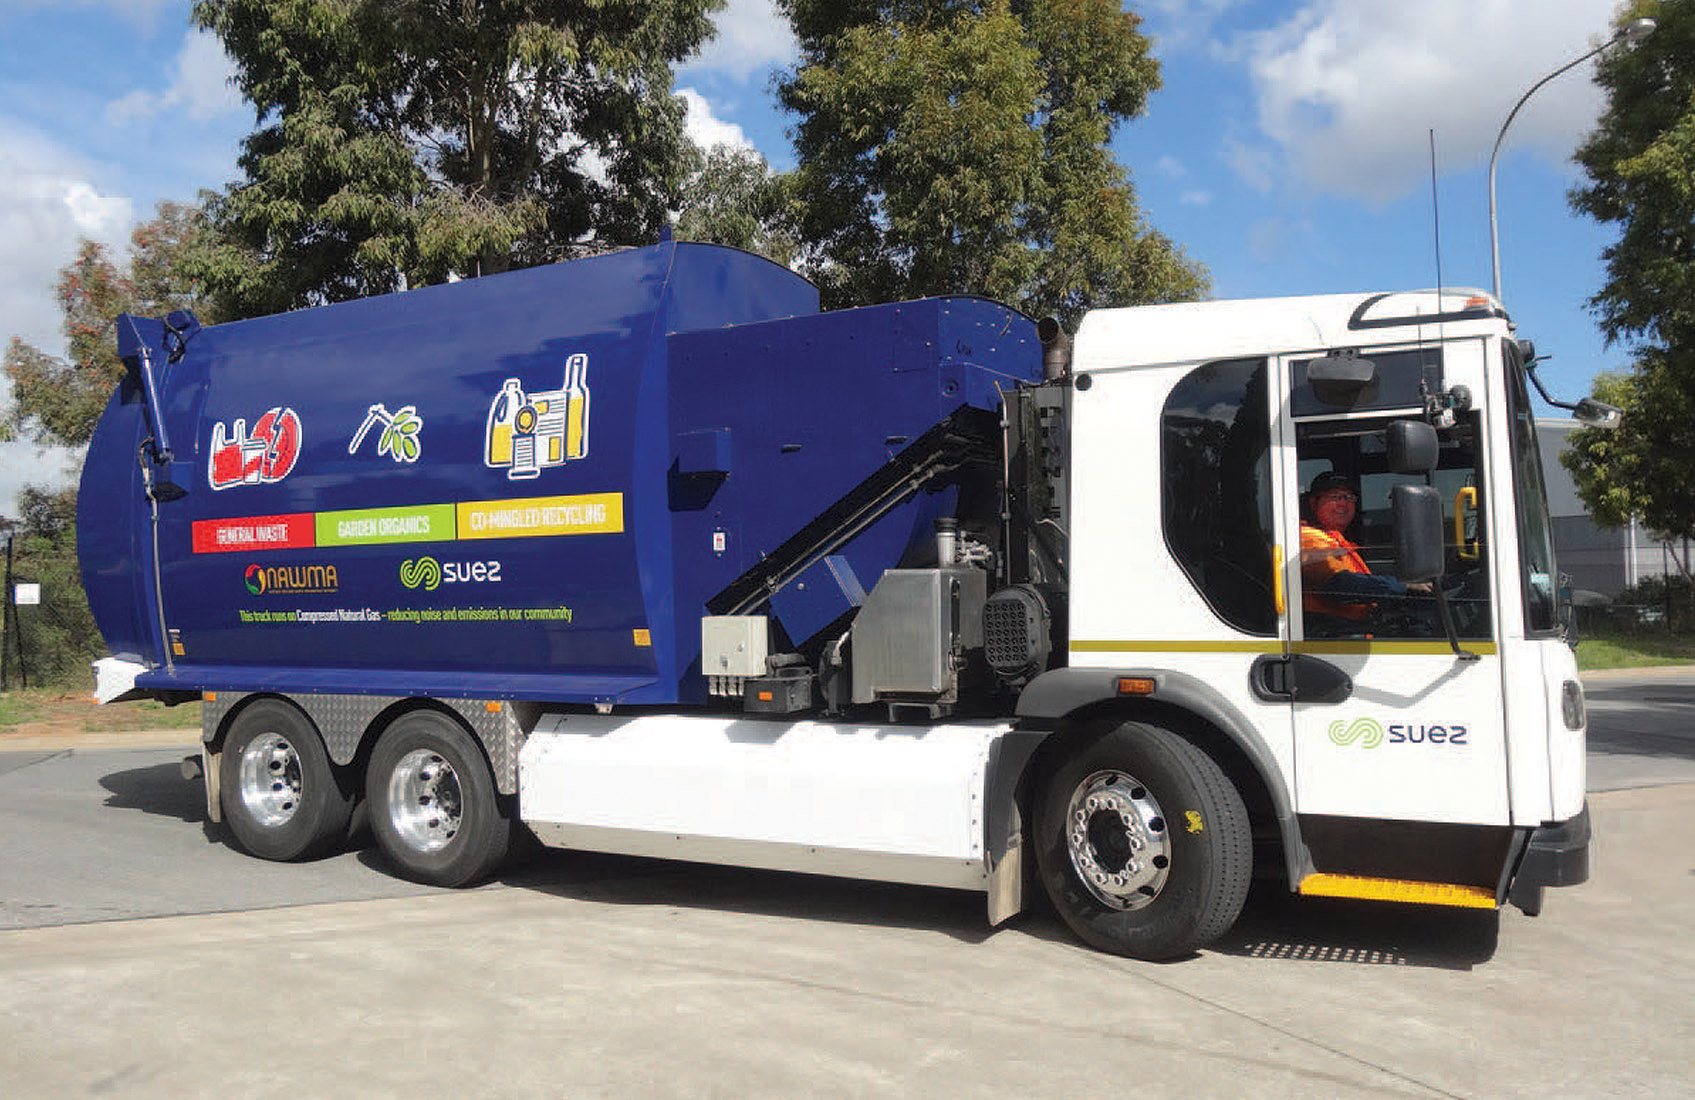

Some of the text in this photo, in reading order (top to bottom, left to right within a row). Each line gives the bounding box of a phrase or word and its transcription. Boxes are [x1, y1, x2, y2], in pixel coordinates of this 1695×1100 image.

[541, 503, 607, 526] RECYCLING
[216, 523, 289, 545] GENERAL WASTE
[337, 514, 431, 539] GARDEN ORGANICS
[239, 608, 254, 622] This
[253, 608, 271, 622] truck
[296, 608, 338, 625] Compressed
[338, 608, 365, 622] Natural
[365, 607, 381, 622] Gas
[387, 607, 421, 625] reducing
[420, 606, 442, 621] noise
[442, 605, 458, 621] and
[457, 606, 499, 621] emissions
[499, 605, 509, 621] in
[508, 609, 522, 621] our
[524, 605, 573, 624] community
